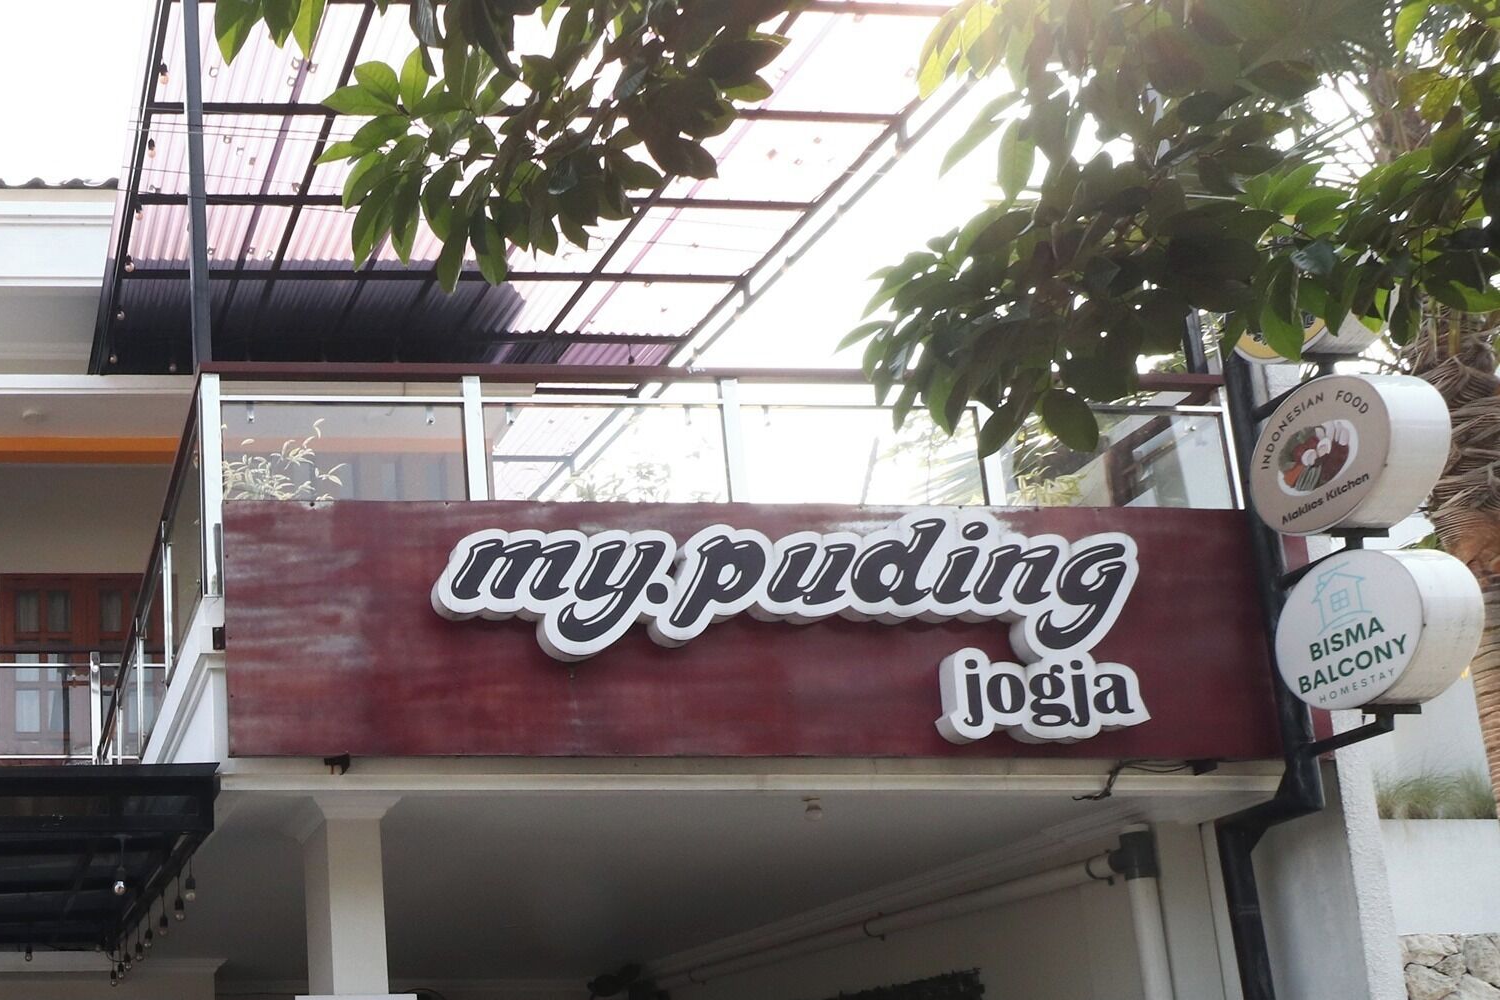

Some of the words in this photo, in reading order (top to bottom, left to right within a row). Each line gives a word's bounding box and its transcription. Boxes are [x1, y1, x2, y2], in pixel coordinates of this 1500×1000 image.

[1261, 392, 1324, 470] INDONESIAN
[1335, 389, 1369, 415] FOOD
[1298, 634, 1408, 694] BALCONY
[1309, 616, 1385, 661] BISMA
[964, 659, 1135, 727] jogja
[1319, 668, 1395, 704] HOMESTAY
